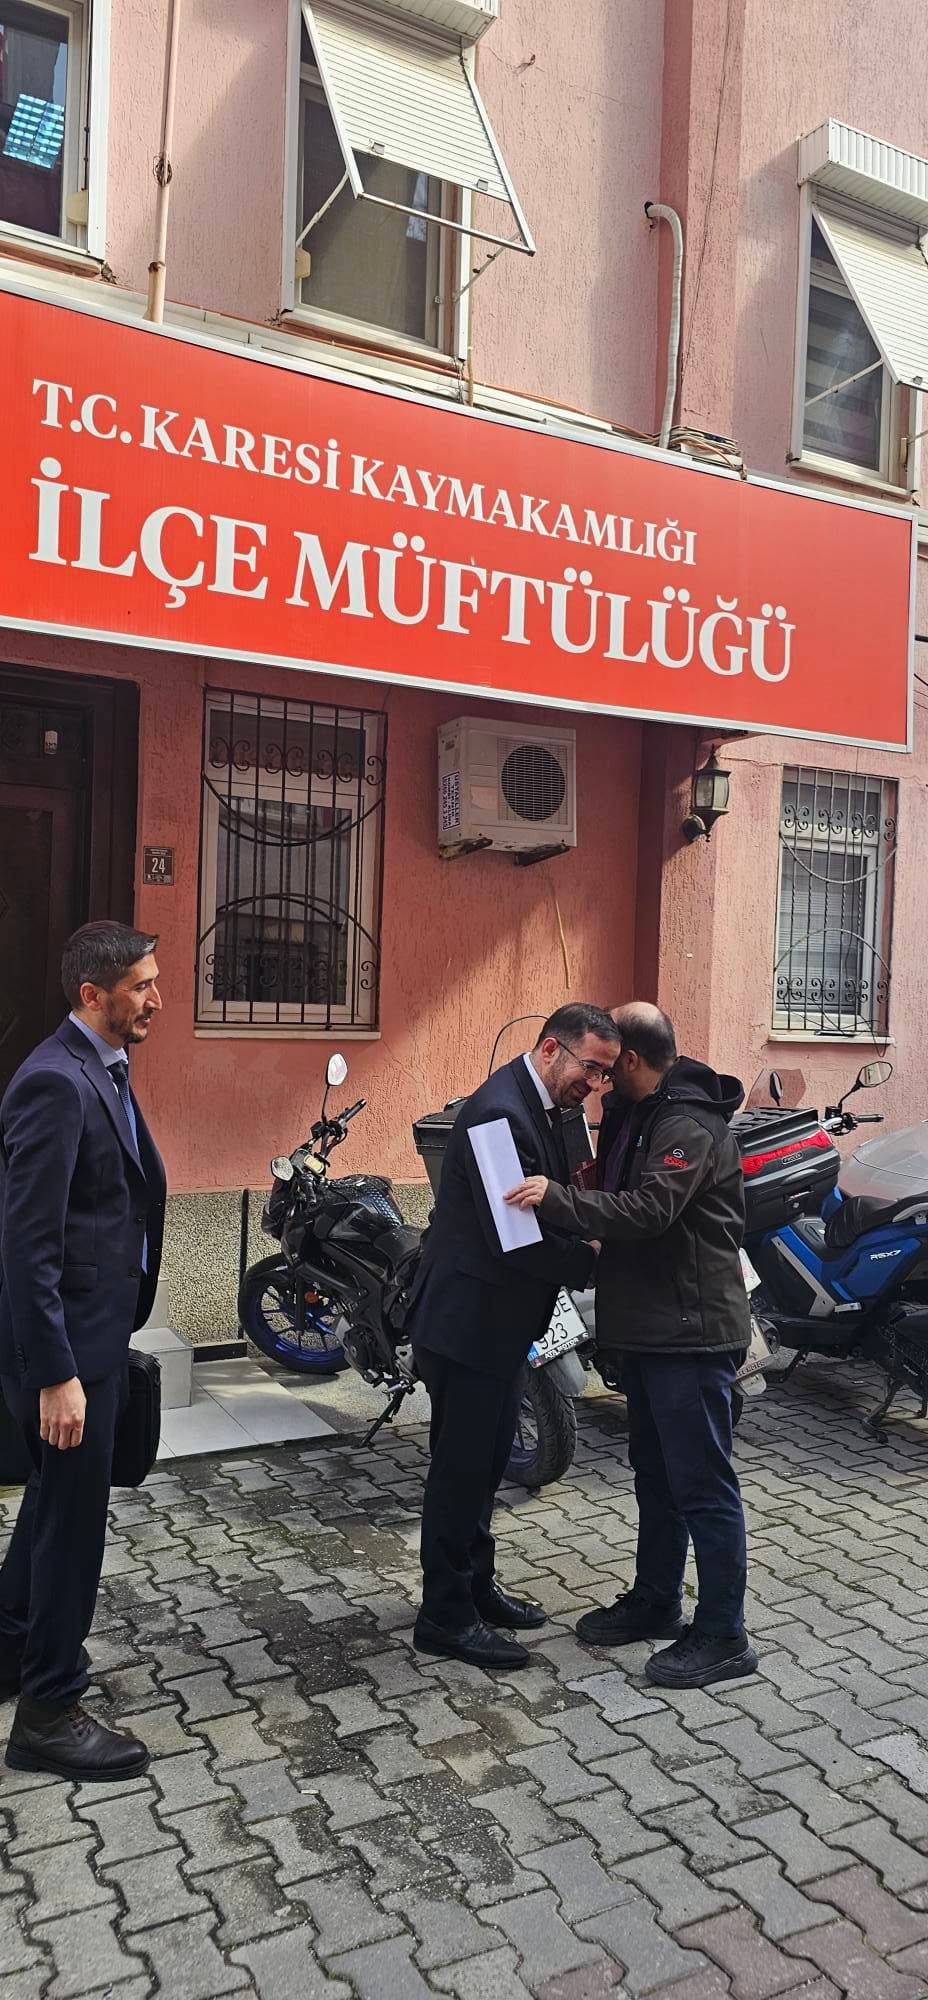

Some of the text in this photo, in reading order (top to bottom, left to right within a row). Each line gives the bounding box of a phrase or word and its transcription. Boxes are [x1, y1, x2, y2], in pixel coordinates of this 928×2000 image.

[33, 378, 697, 566] T.C. KARESİ KAYMAKAMLIĞI
[29, 457, 796, 683] İLÇE MÜFTÜLÜĞÜ
[151, 857, 166, 873] 24
